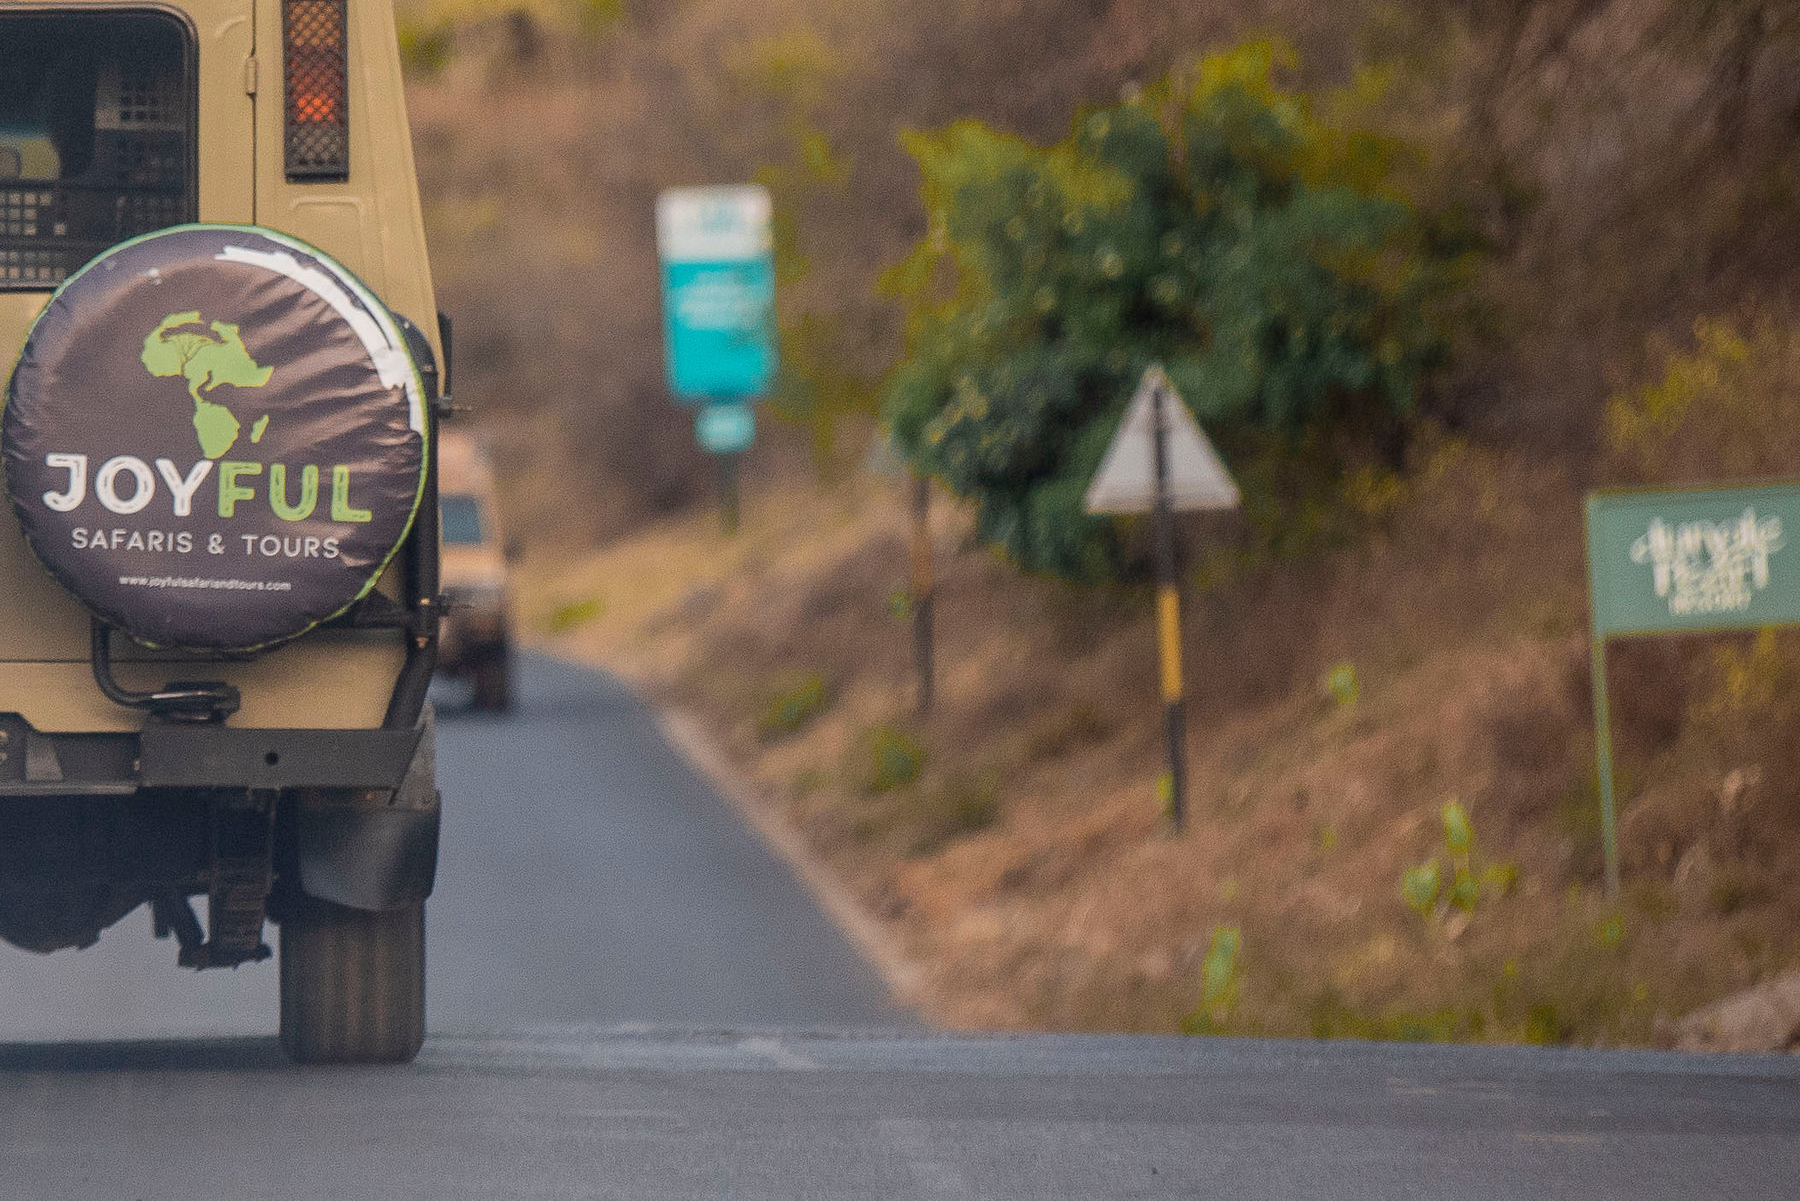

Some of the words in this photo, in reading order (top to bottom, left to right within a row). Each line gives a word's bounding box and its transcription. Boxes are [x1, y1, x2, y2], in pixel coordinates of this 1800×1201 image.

[43, 453, 373, 522] JOYFUL
[71, 527, 193, 554] SAFARIS
[208, 533, 226, 555] &
[241, 534, 340, 559] TOURS
